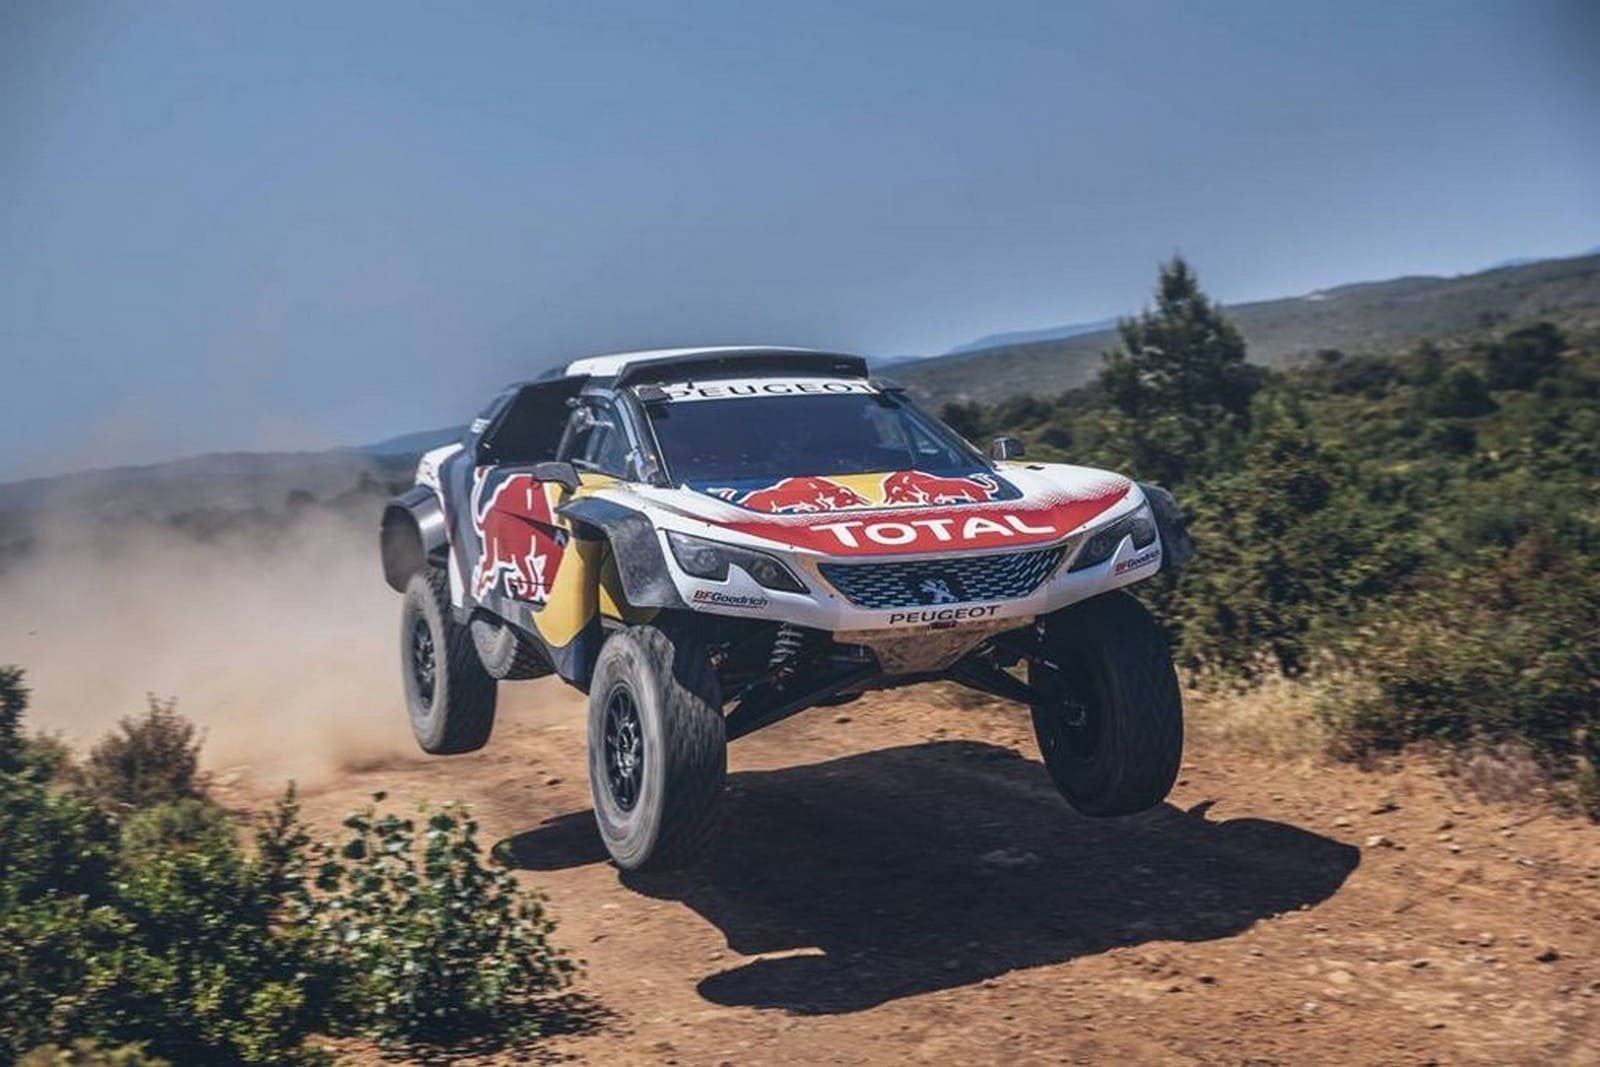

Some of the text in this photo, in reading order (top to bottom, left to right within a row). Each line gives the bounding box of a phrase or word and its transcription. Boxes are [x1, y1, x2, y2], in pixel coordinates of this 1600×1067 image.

[808, 514, 1057, 548] TOTAL
[693, 589, 768, 607] BFGoodrich
[889, 605, 1000, 625] PEUGEOT
